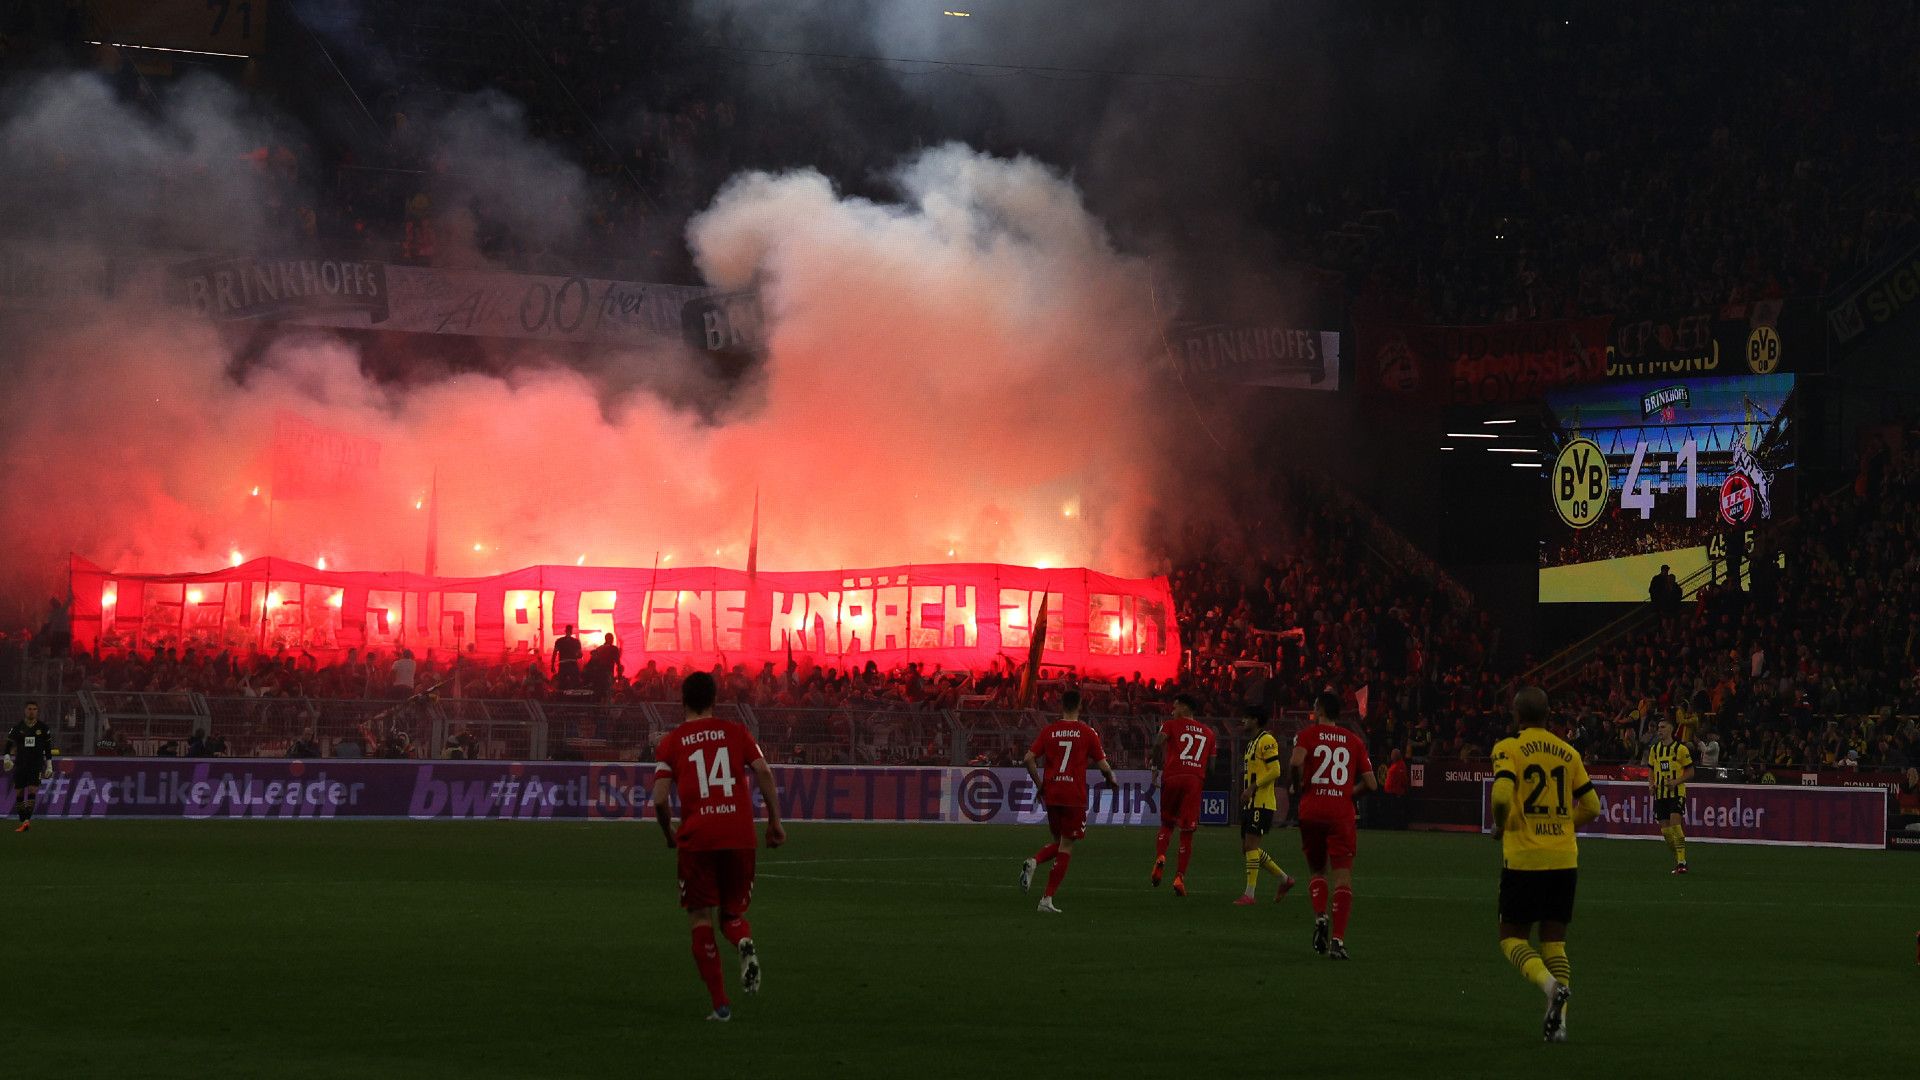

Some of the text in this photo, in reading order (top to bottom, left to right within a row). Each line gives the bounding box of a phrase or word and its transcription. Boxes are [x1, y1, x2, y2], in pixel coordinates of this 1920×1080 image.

[1866, 260, 1920, 322] SIG
[1751, 329, 1776, 362] BVB
[1561, 448, 1603, 501] BVB
[1620, 440, 1697, 519] 4:1
[1572, 499, 1588, 518] 09
[503, 589, 618, 653] ALS
[642, 589, 746, 652] ENE
[769, 574, 977, 653] KNÄÄCH
[681, 729, 726, 746] HECTOR
[1179, 733, 1207, 761] 27
[1319, 732, 1347, 743] SKHIRI
[1520, 740, 1573, 762] DORTMUND
[1058, 741, 1073, 773] 7
[1311, 744, 1350, 786] 28
[688, 746, 736, 799] 14
[1445, 771, 1472, 782] SIGNAL
[1327, 788, 1343, 797] KÖLN
[1523, 763, 1568, 816] 21
[716, 804, 737, 815] KÖLN
[1203, 798, 1225, 815] 1&1
